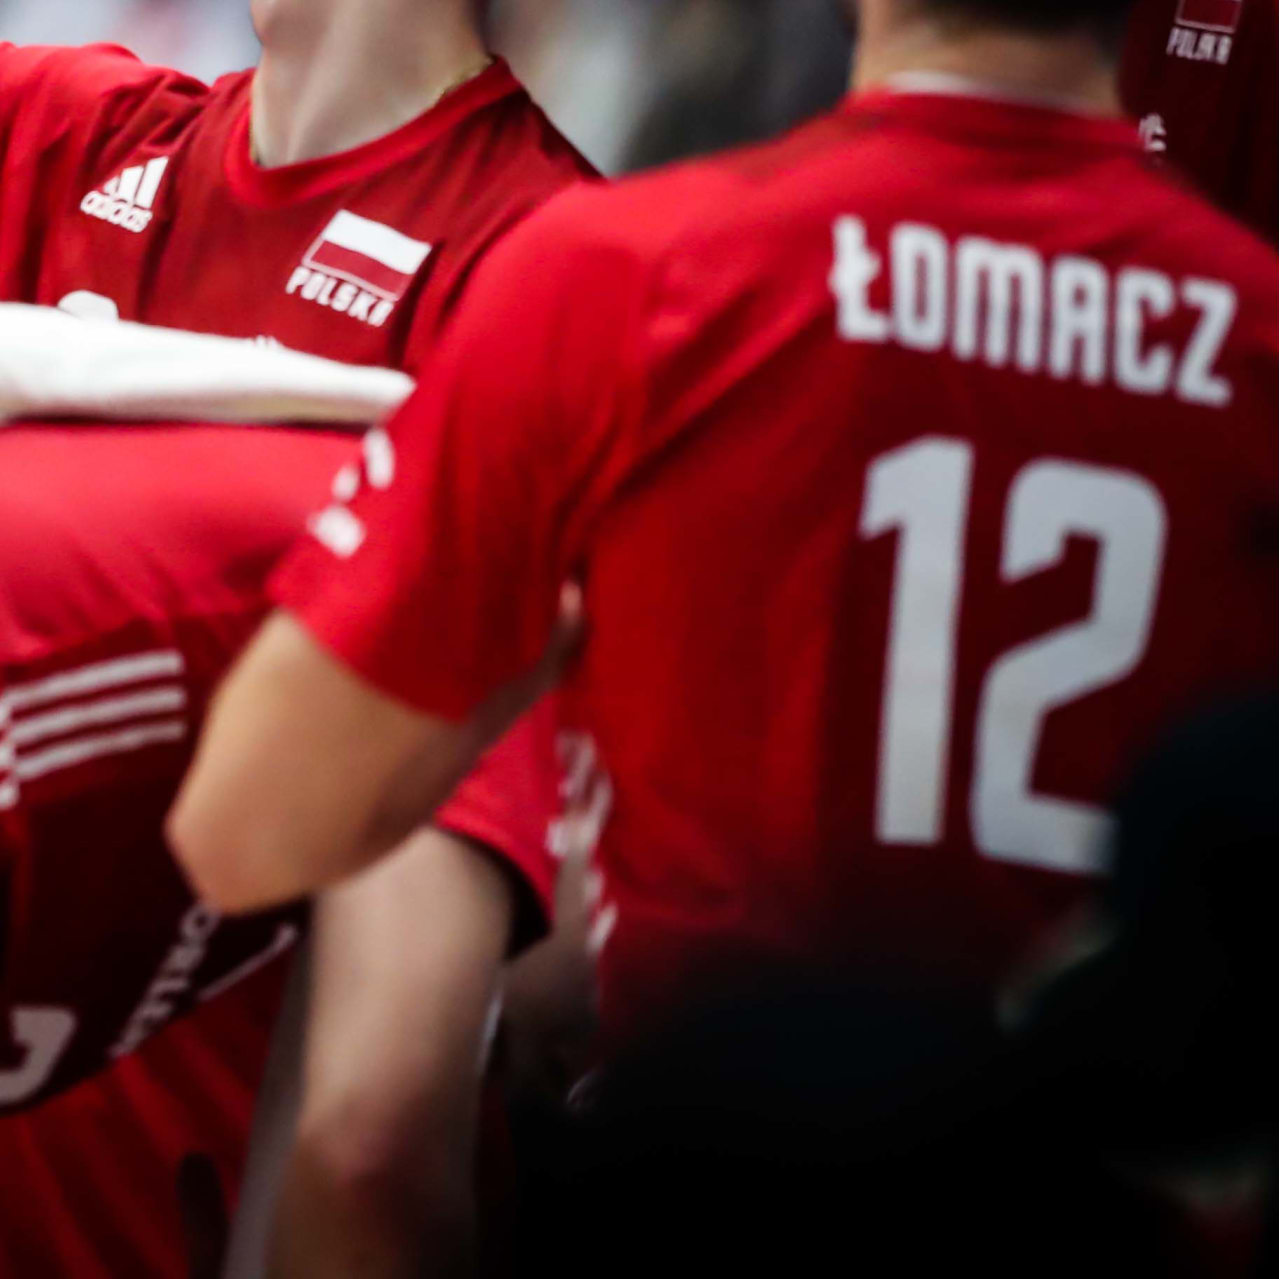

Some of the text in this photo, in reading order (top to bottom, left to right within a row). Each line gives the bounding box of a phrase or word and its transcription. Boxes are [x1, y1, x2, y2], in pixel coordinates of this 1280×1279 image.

[80, 189, 154, 234] adidas
[285, 265, 396, 328] POLSKA
[829, 215, 1236, 406] ŁOMACZ
[861, 436, 1168, 876] 12
